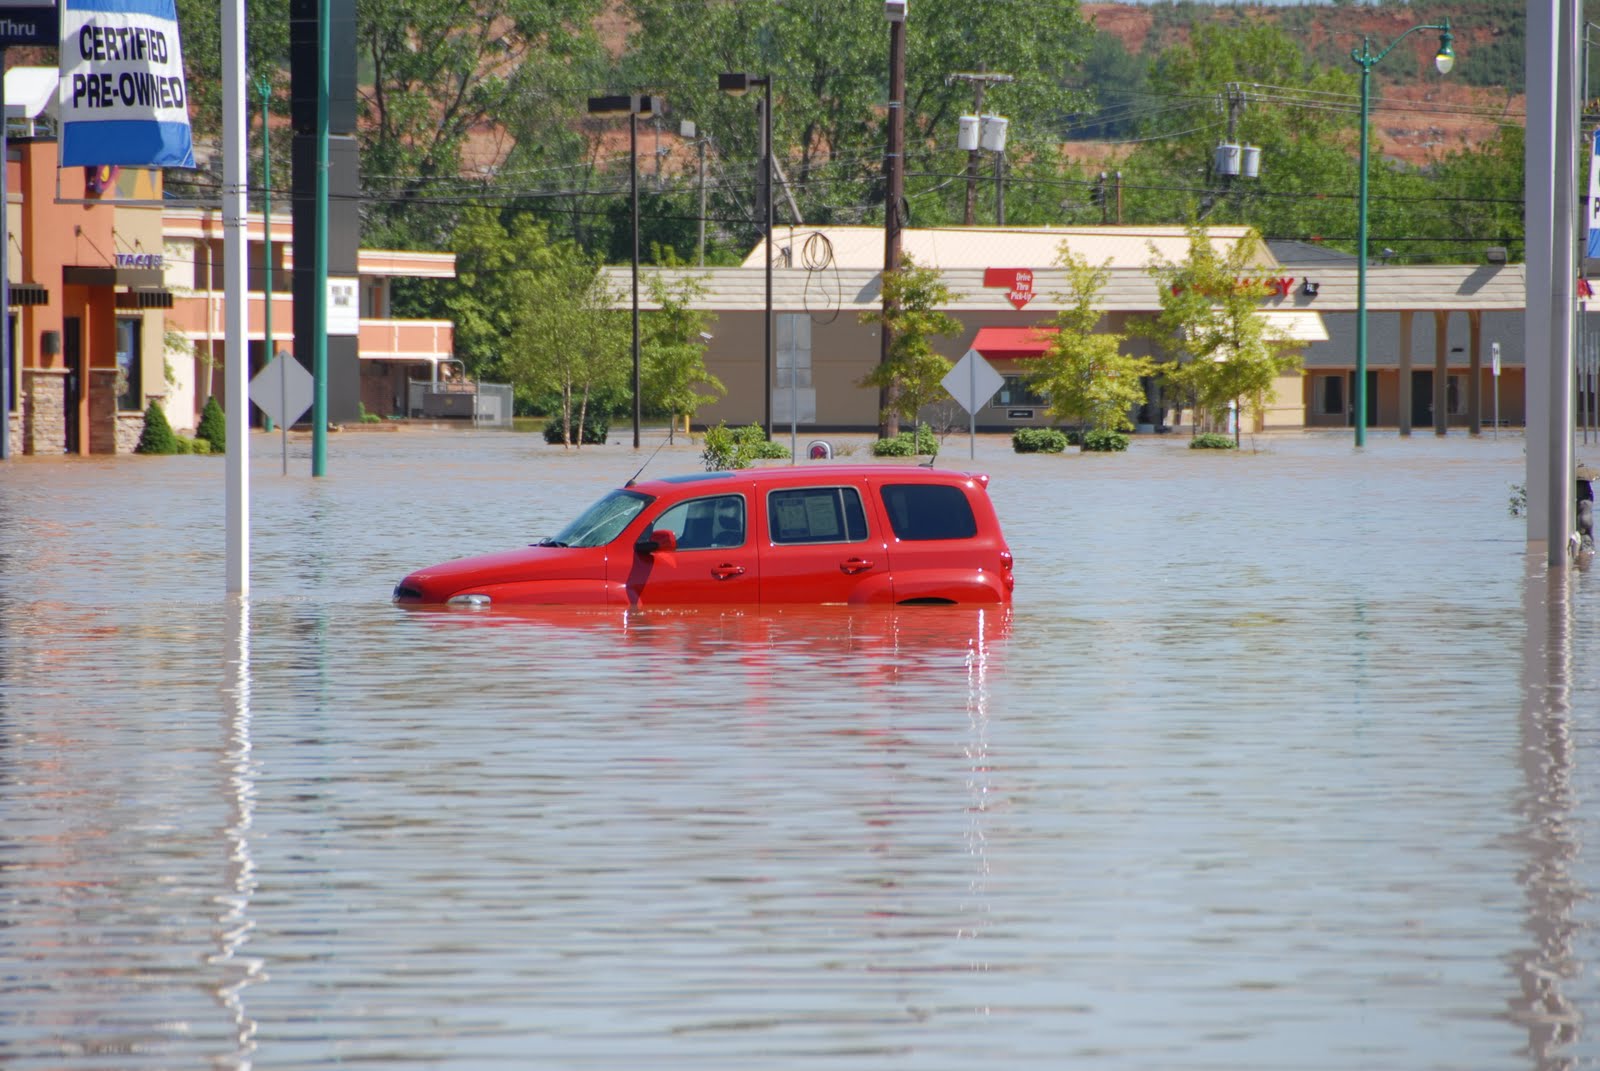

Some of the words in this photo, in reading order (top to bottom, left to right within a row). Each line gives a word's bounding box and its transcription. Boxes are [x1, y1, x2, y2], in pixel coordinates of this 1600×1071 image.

[0, 19, 36, 36] Thru
[79, 24, 168, 64] CERTIFIED
[73, 72, 184, 109] PRE-OWNED
